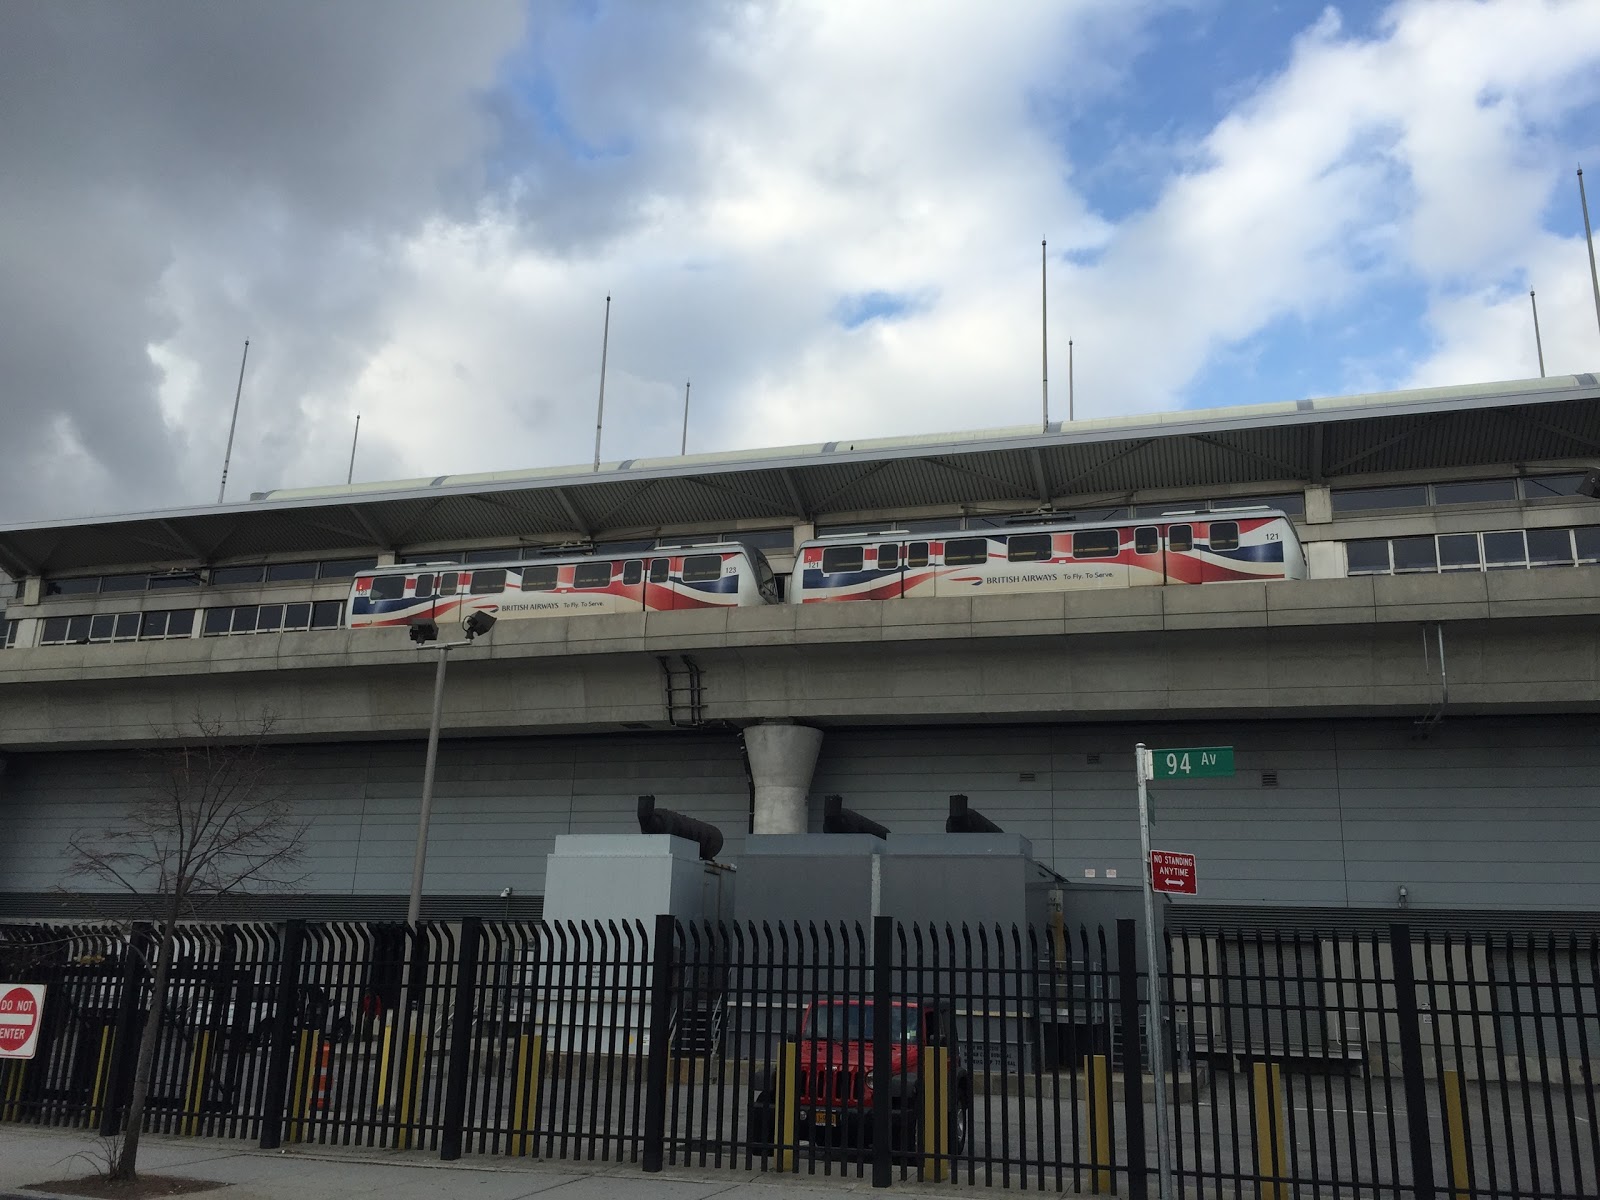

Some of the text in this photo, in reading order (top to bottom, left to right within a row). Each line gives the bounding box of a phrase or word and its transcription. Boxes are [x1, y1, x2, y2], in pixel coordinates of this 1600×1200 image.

[1265, 532, 1279, 541] 121
[725, 566, 737, 574] 123
[986, 575, 1020, 584] BRITISH
[1021, 573, 1058, 583] AIRWAYS
[501, 604, 529, 612] BRITISH
[529, 602, 559, 611] AIRWAYS
[1166, 752, 1191, 775] 94
[1153, 855, 1193, 867] NO STANDING
[1159, 866, 1189, 877] ANYTIME
[0, 1000, 33, 1011] DO NOT
[0, 1028, 25, 1039] ENTER
